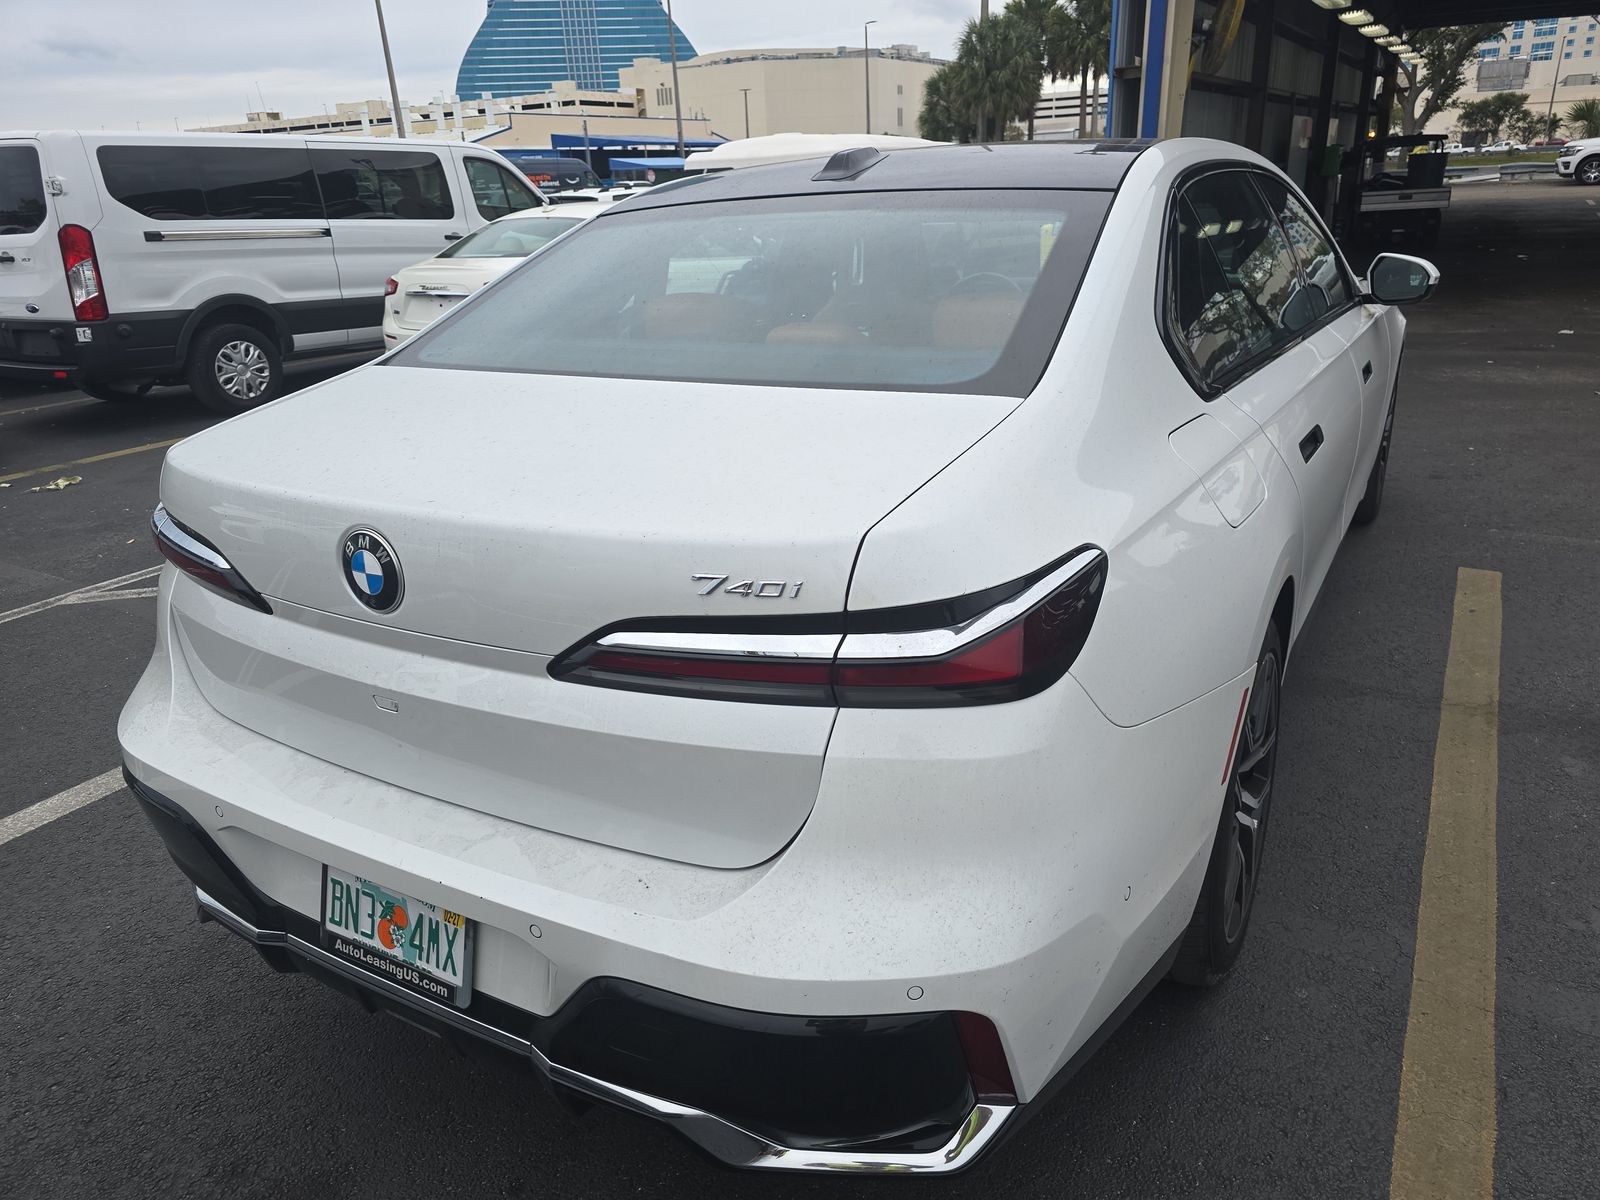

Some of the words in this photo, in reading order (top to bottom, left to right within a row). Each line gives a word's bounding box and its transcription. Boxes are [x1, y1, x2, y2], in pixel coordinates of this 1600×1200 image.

[345, 534, 391, 565] BMW
[690, 573, 804, 599] 740i
[328, 876, 376, 940] BN3
[409, 912, 459, 977] 4MX
[334, 938, 448, 998] AutoLeasingUS.com
